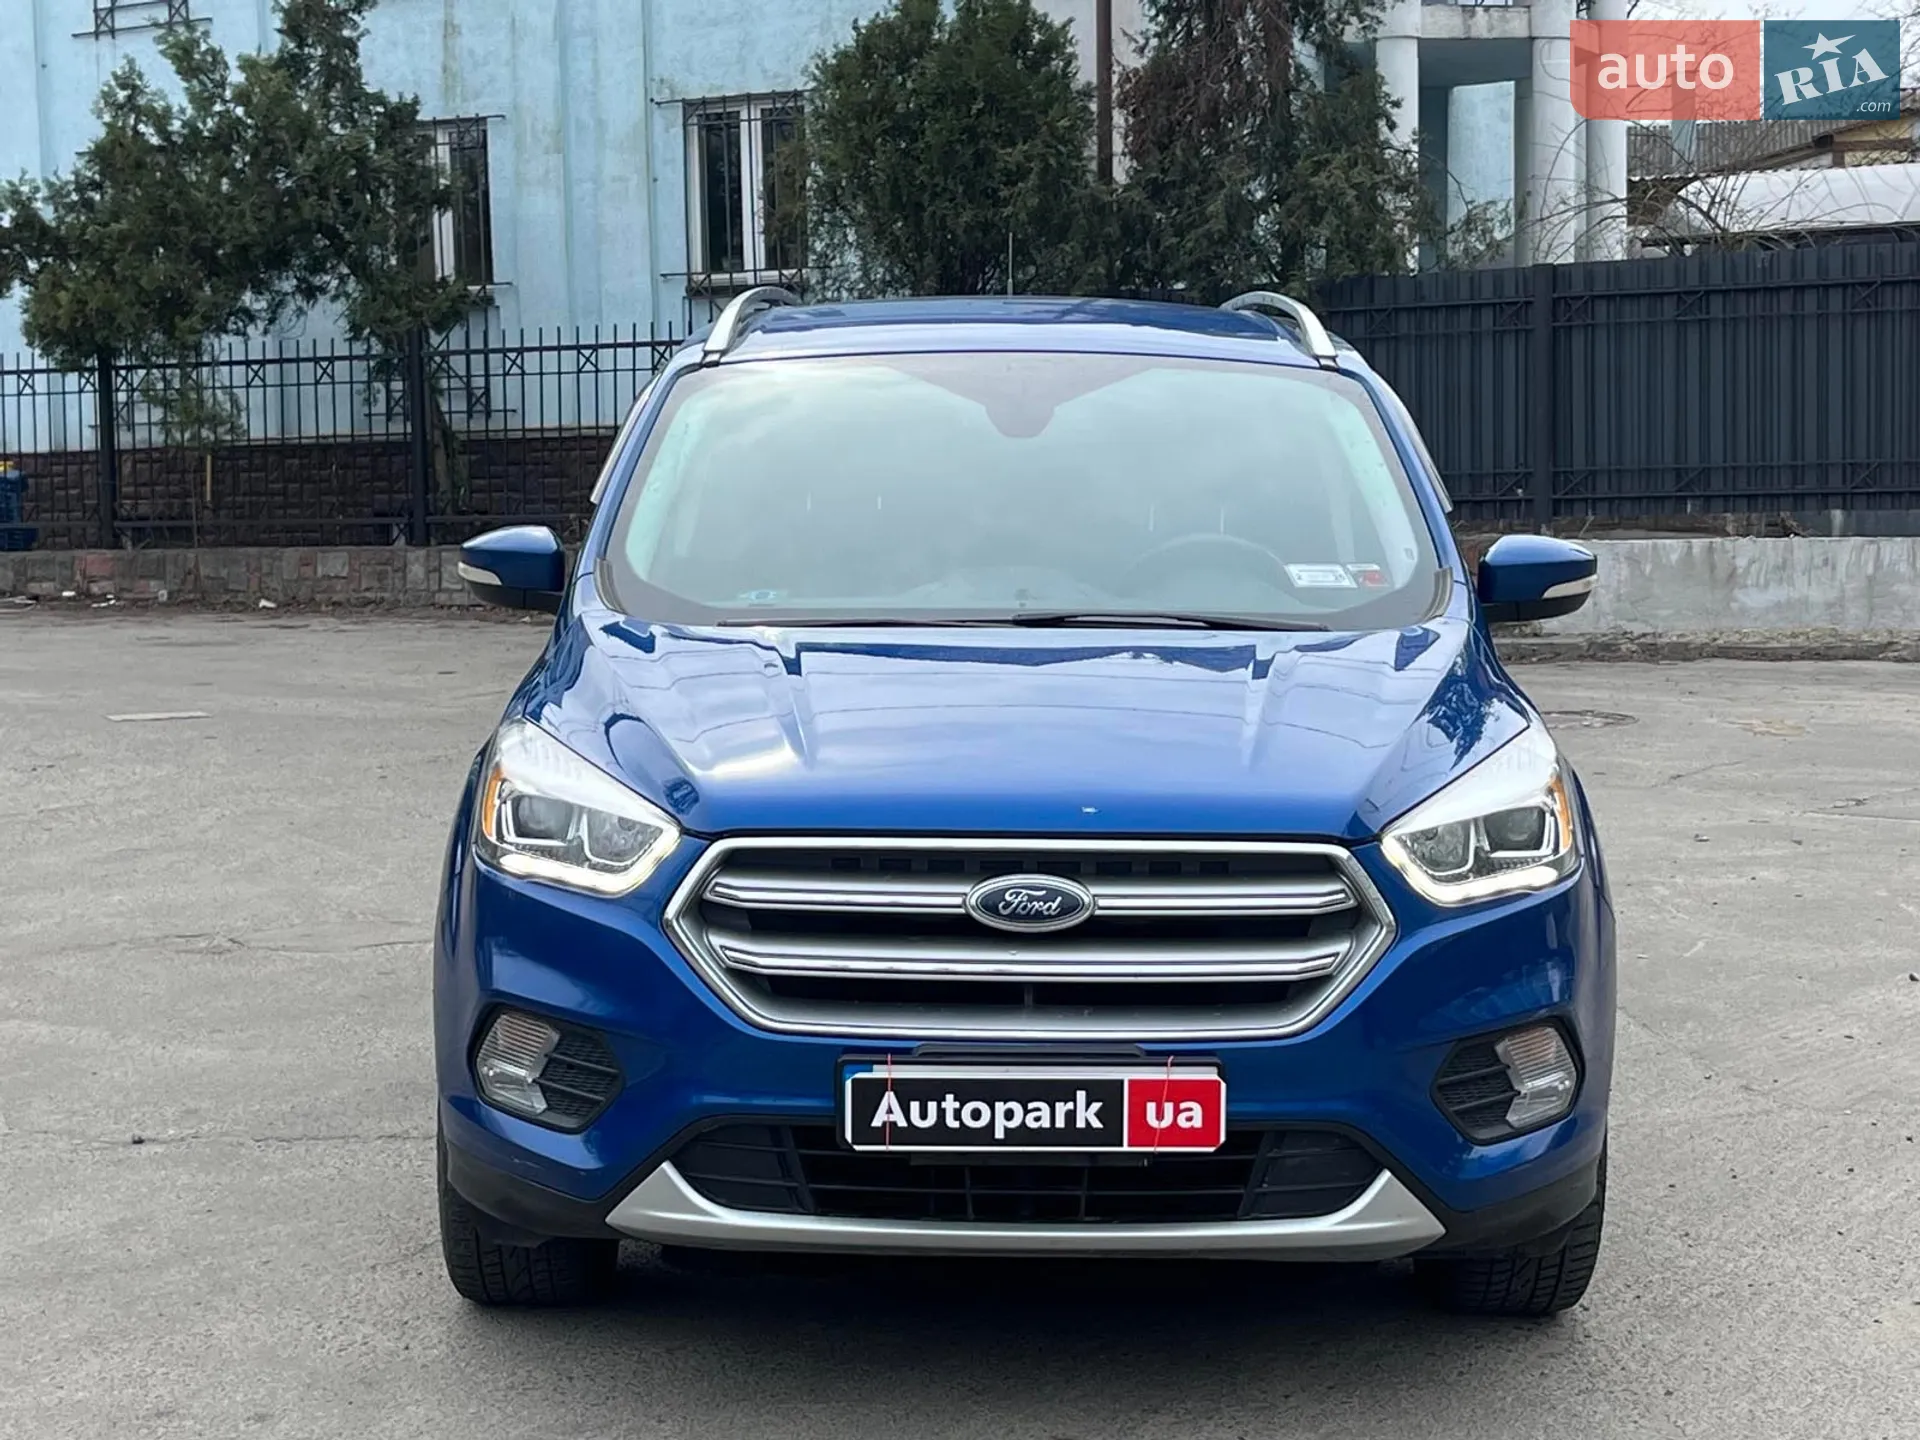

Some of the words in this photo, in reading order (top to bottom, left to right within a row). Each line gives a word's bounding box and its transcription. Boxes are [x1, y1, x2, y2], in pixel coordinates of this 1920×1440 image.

[998, 888, 1062, 916] Ford
[870, 1090, 1104, 1139] Autopark
[1145, 1101, 1204, 1129] ua
